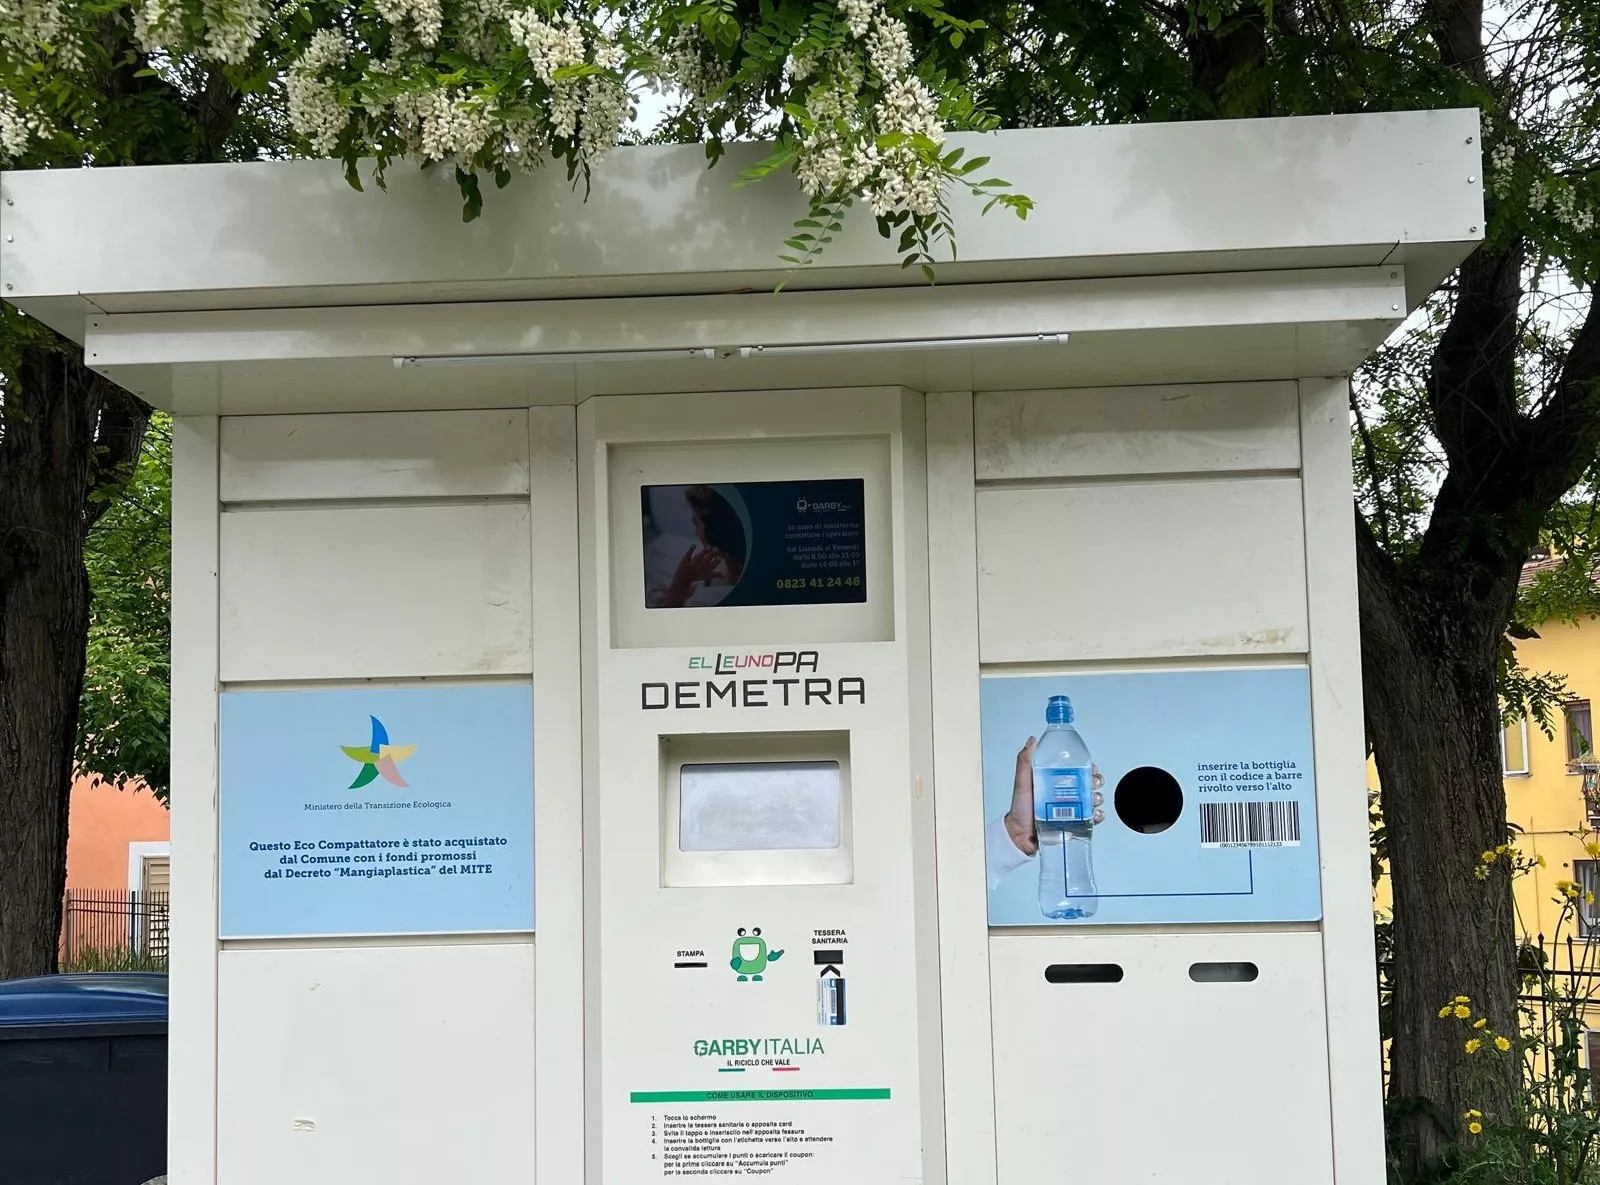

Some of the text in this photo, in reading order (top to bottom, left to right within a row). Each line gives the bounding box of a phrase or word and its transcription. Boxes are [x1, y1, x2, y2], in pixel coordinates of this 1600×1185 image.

[777, 577, 860, 588] 0823 41 24 48
[642, 677, 865, 710] DEMETRA
[1197, 760, 1296, 771] inserire la bottiglia
[1198, 774, 1218, 782] con
[1220, 772, 1228, 781] il
[1230, 771, 1264, 780] codice
[1275, 771, 1302, 779] barre
[1199, 783, 1233, 792] rivolto
[1266, 782, 1291, 791] l'alto
[364, 801, 411, 810] Transizione
[413, 801, 451, 810] Ecologica
[250, 837, 508, 851] Questo Eco Compattatore è stato acquistato
[280, 854, 298, 864] dal
[300, 854, 351, 863] Comune
[378, 853, 384, 862] i
[386, 852, 418, 862] fondi
[421, 851, 476, 863] promossi
[264, 868, 282, 879] dal
[285, 868, 331, 878] Decreto
[439, 865, 457, 875] del
[461, 864, 492, 874] MITE
